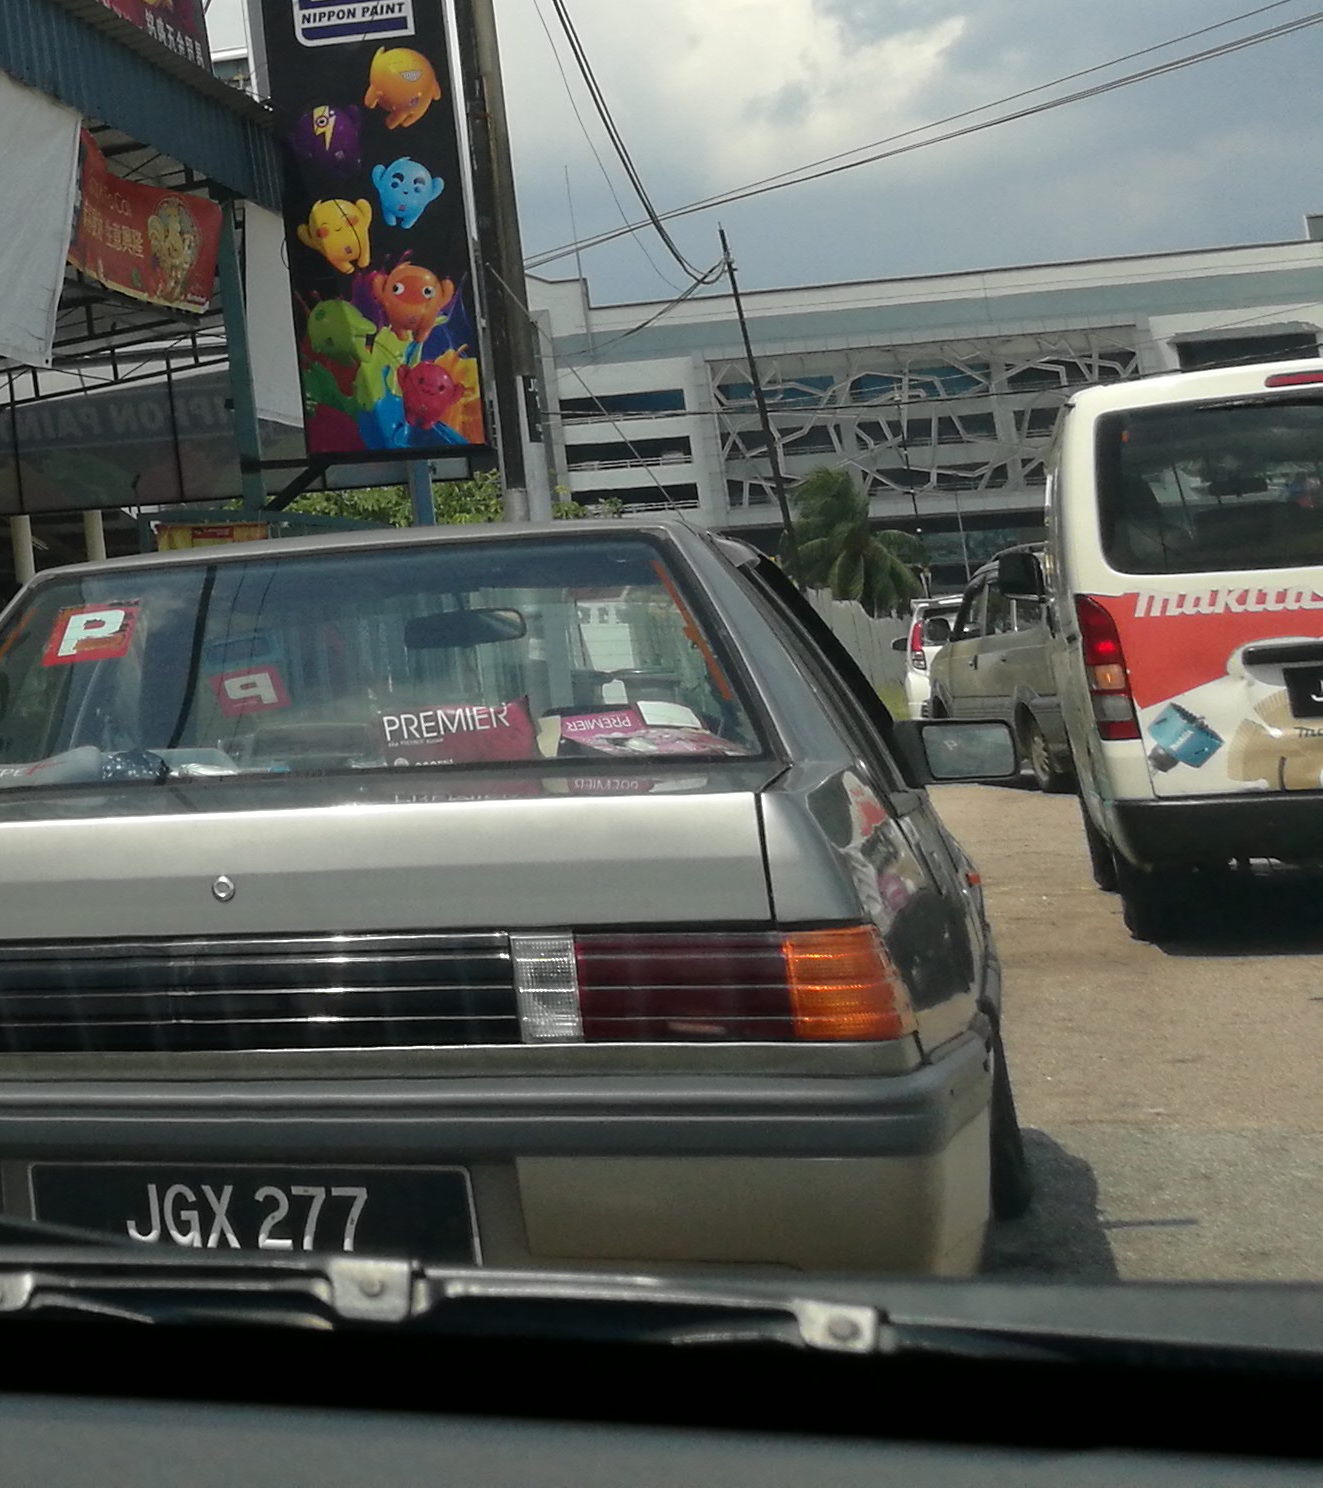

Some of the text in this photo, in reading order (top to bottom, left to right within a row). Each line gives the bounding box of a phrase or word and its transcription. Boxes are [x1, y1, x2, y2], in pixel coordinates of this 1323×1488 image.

[301, 2, 405, 25] NIPPON PAINT
[57, 608, 126, 658] P
[382, 701, 511, 742] PREMIER
[565, 714, 633, 733] PREMIER
[126, 1183, 369, 1251] JGX 277
